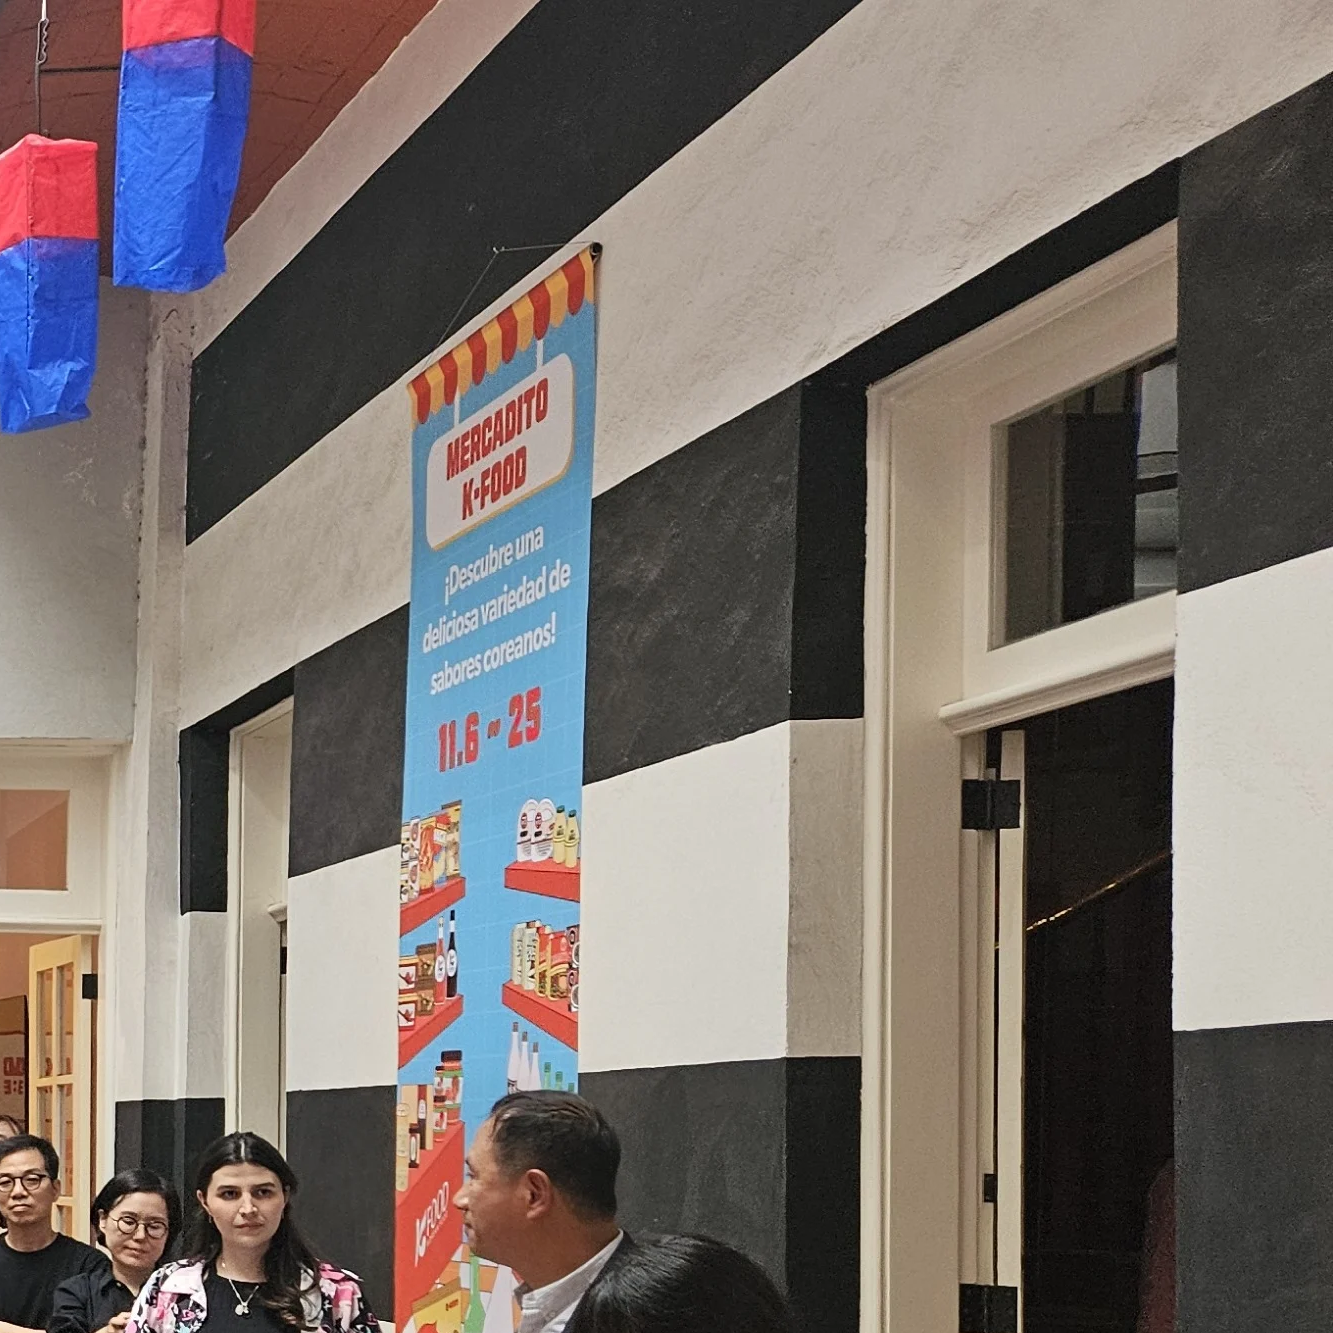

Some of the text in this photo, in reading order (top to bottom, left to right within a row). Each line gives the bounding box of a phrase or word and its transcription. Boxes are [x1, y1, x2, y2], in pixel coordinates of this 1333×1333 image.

[446, 376, 550, 482] MERCADITO
[461, 445, 528, 523] K-FOOD
[422, 559, 571, 654] deliciosa variedad de
[443, 524, 545, 606] ¡Descubre una
[430, 612, 557, 695] sabores coreanos!
[438, 712, 481, 773] 11.6
[508, 686, 543, 749] 25
